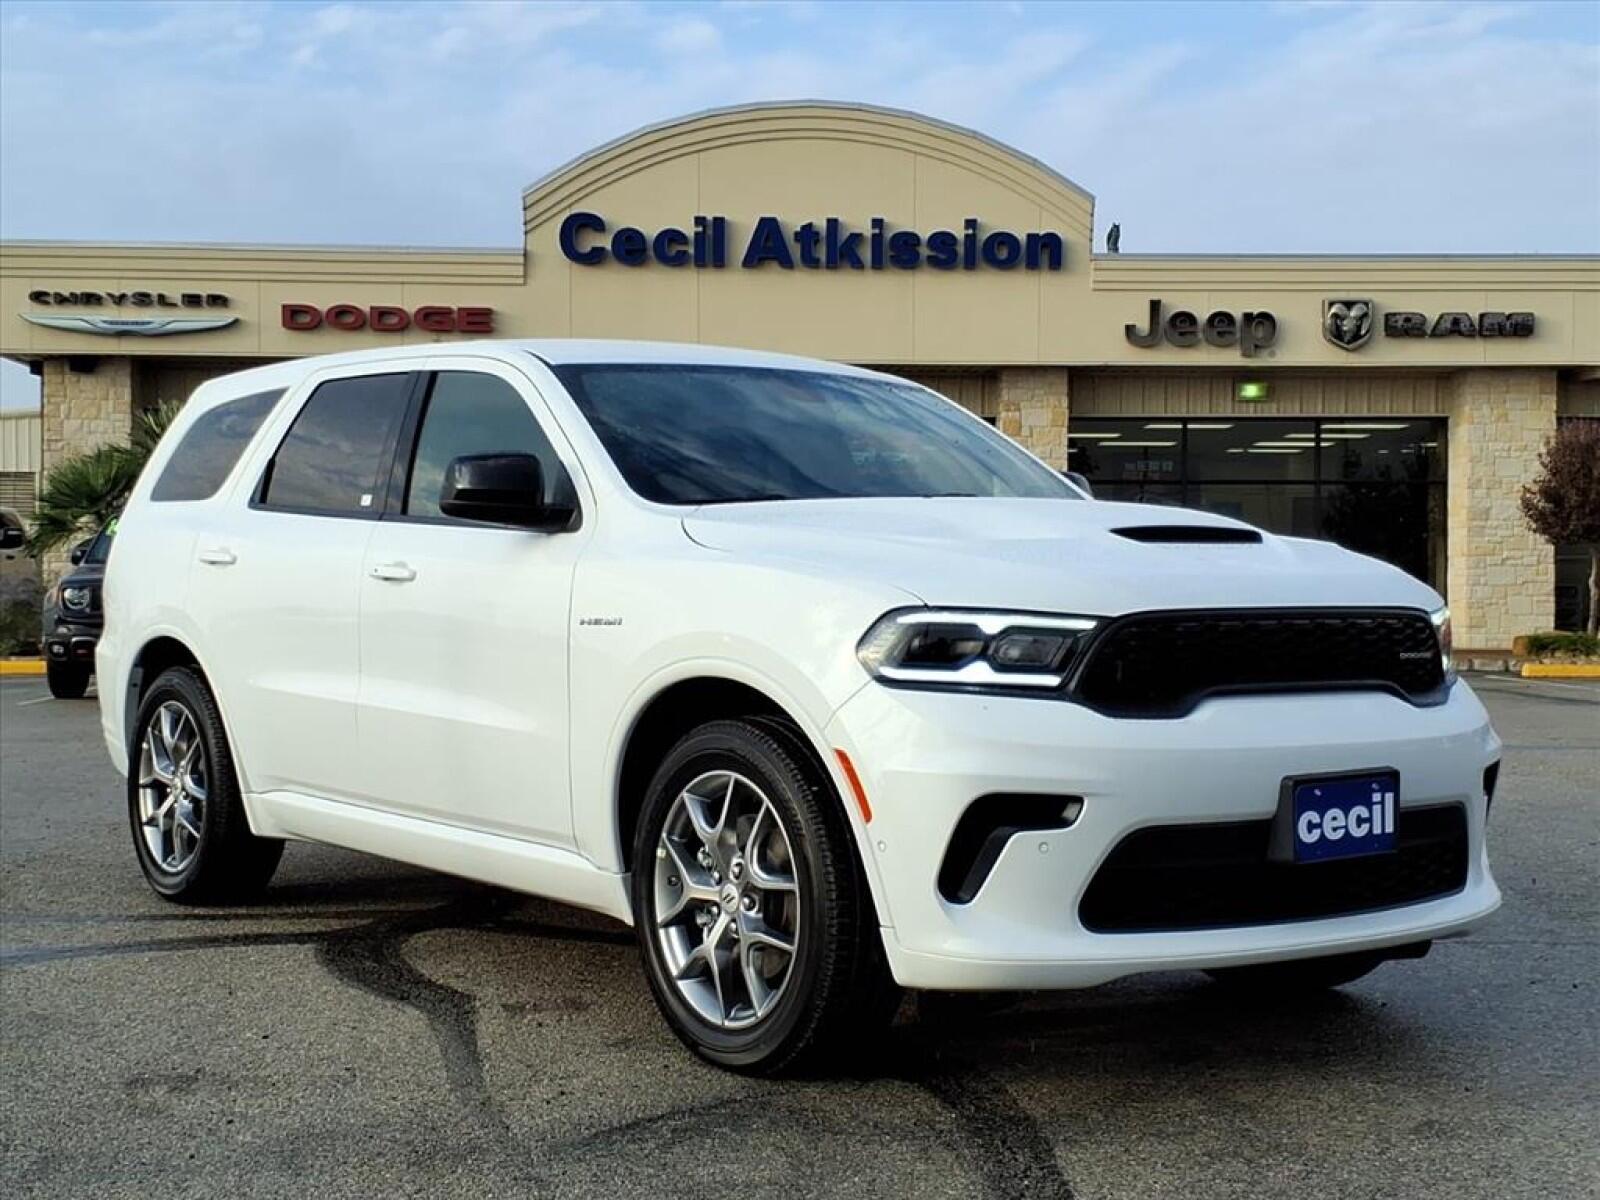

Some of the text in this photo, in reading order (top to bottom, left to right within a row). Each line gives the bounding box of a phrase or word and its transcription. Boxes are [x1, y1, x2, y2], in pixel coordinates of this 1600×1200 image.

[559, 211, 1064, 271] Cecil Atkission
[28, 290, 230, 308] CHRYSLER
[281, 303, 495, 333] DODGE
[1124, 299, 1278, 358] Jeep
[1384, 312, 1536, 338] RAM
[1297, 791, 1395, 844] cecil
